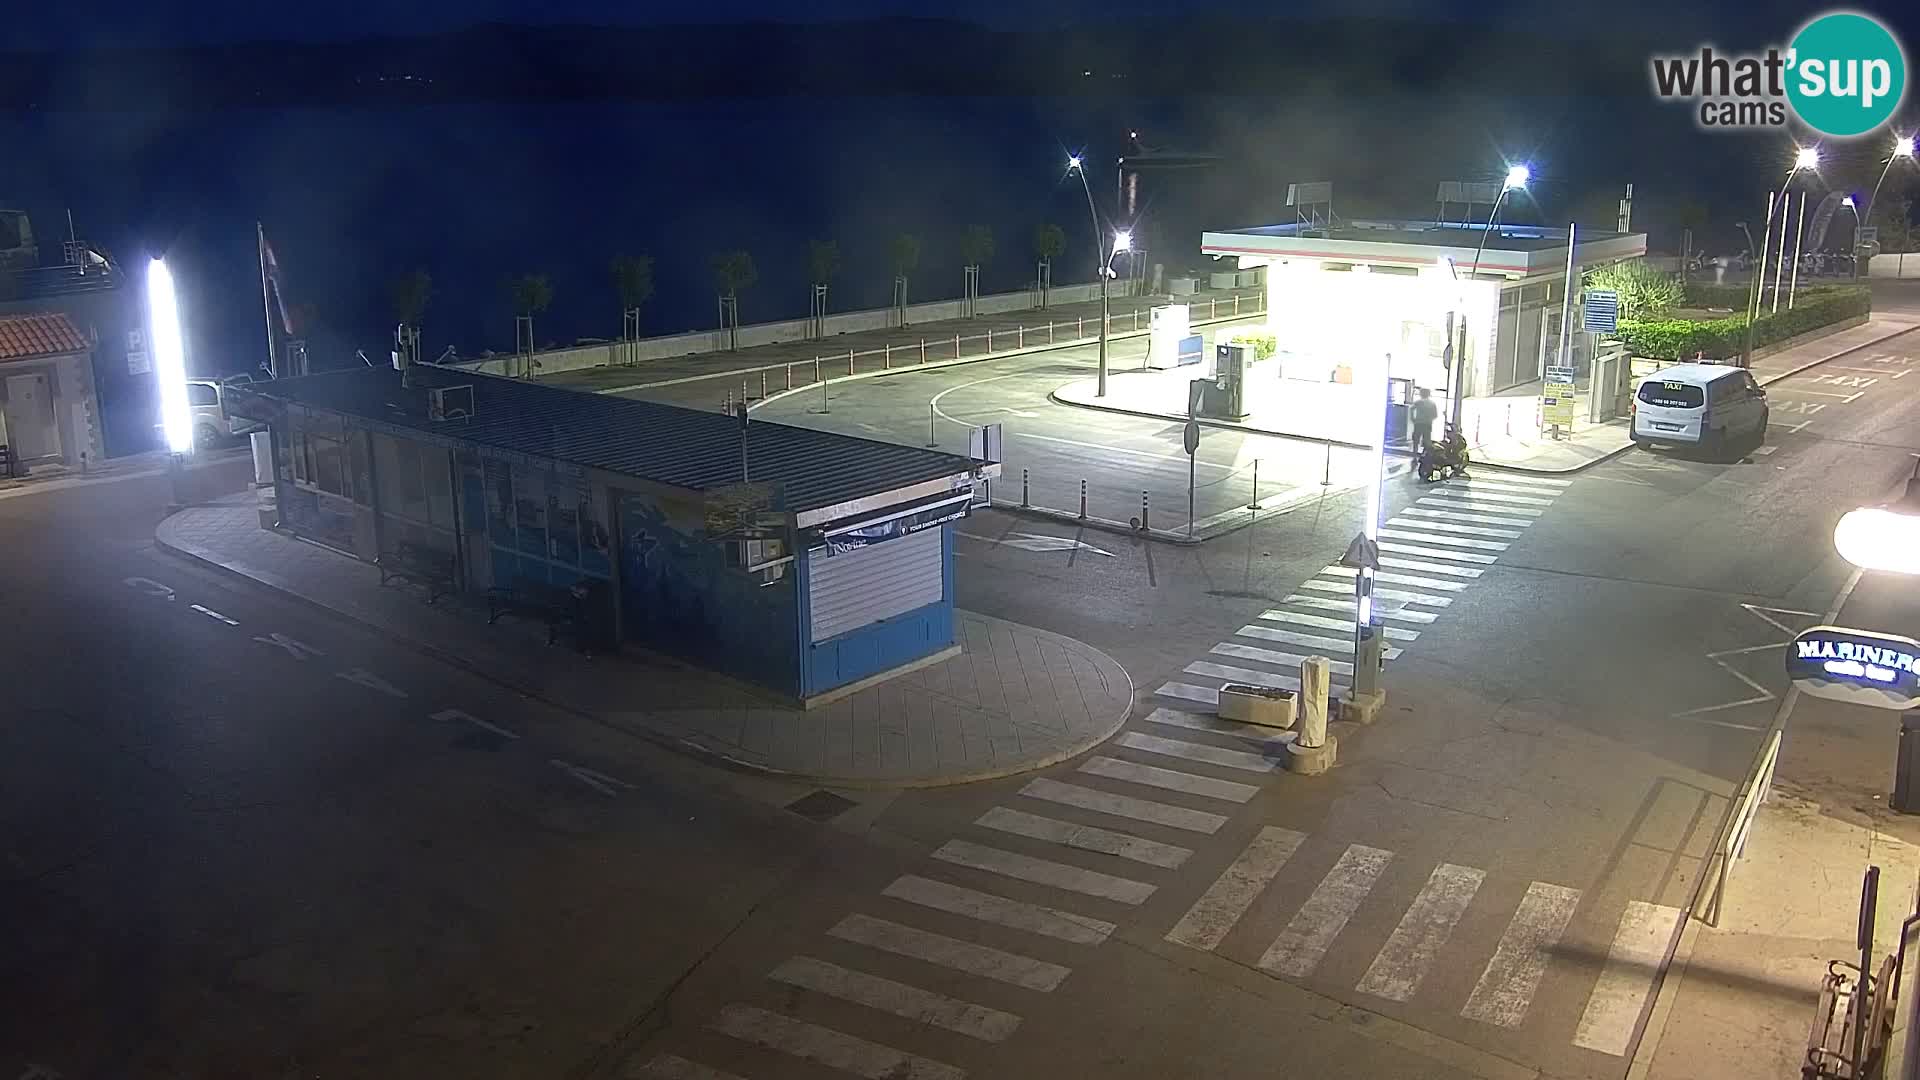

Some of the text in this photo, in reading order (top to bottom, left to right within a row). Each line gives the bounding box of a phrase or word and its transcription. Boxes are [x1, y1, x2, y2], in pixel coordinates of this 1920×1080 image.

[1810, 374, 1879, 388] TAXI
[1664, 382, 1682, 390] TAXI
[910, 523, 922, 532] YOUR
